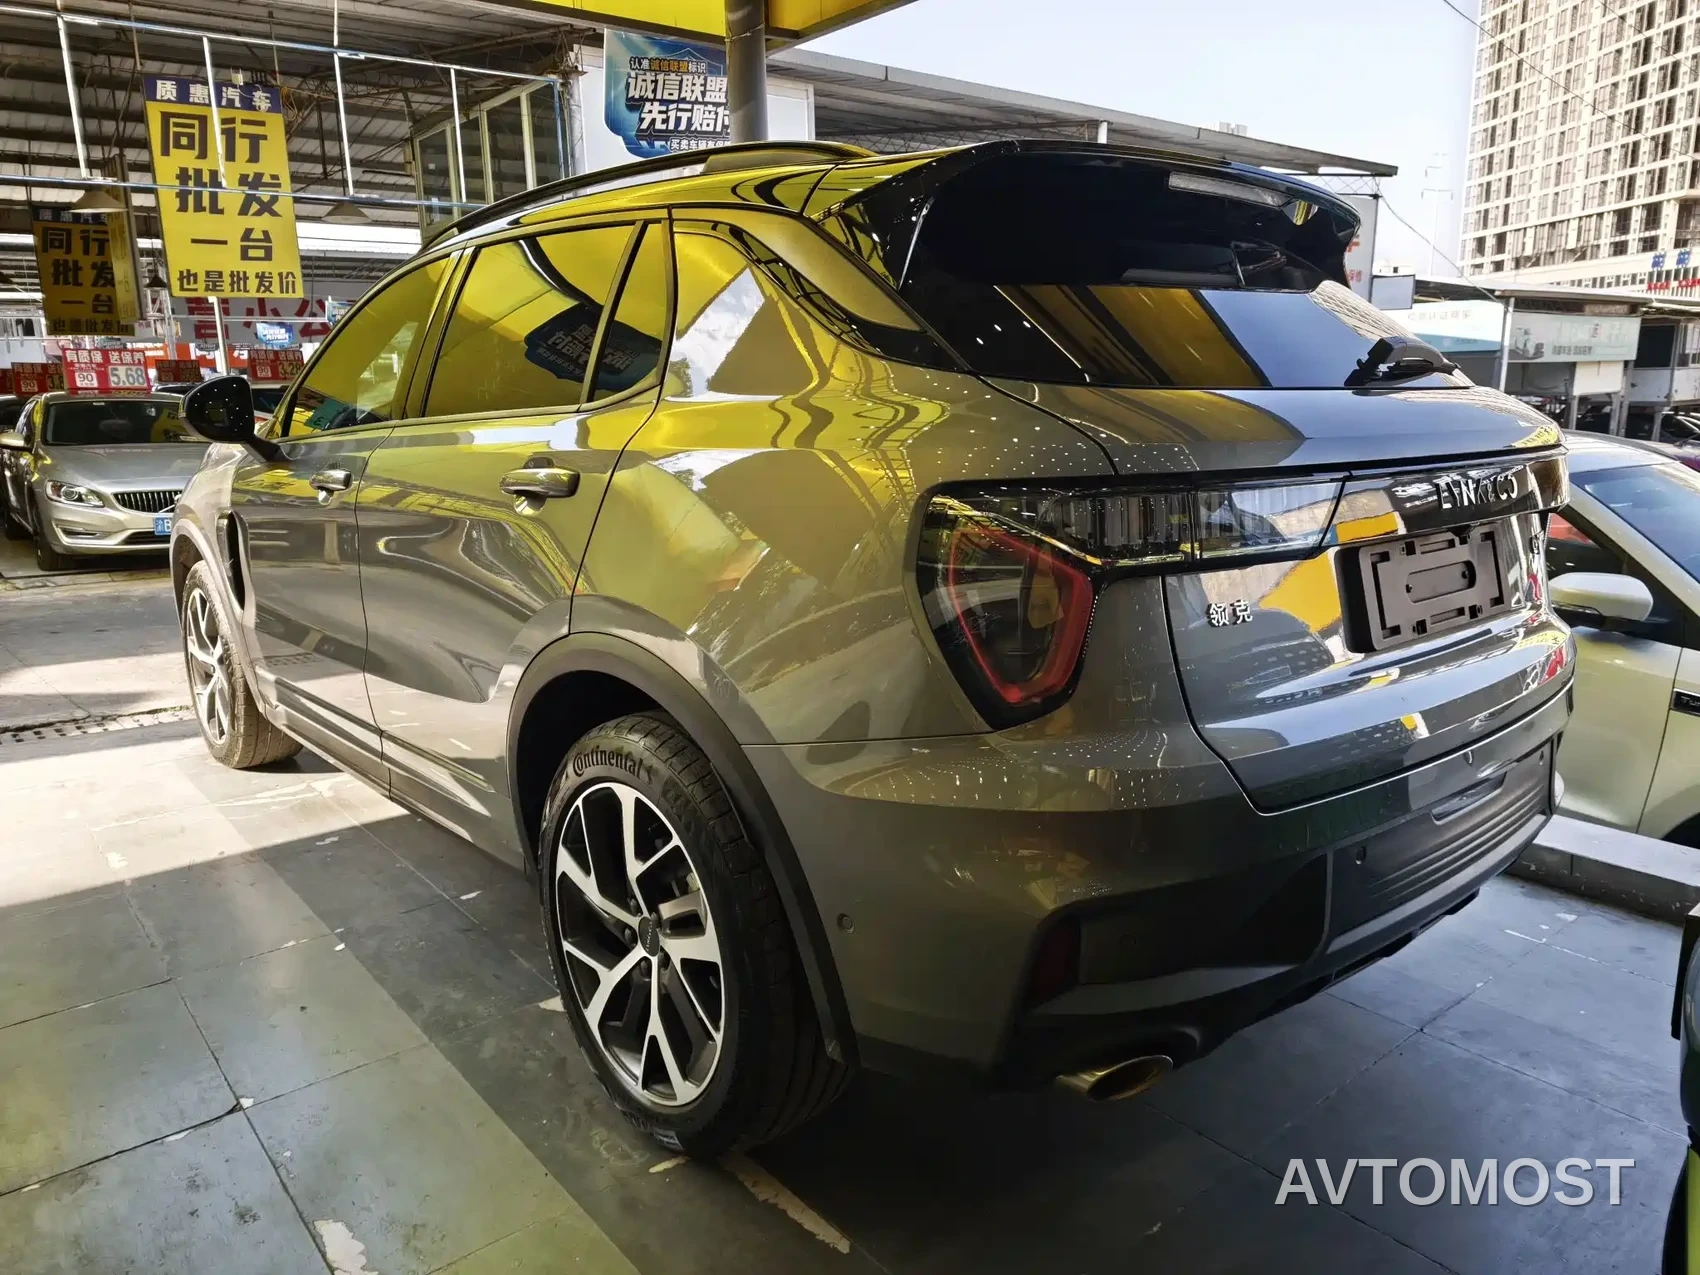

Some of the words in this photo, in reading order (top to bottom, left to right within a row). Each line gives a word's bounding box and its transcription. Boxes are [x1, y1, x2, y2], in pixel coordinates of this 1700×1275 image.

[630, 57, 707, 73] 认准诚信联盟标识
[627, 72, 728, 103] 诚信联盟
[160, 111, 268, 164] 同行
[175, 166, 283, 218] 批发
[190, 227, 273, 262] 一台
[177, 268, 297, 294] 也是批发价
[77, 373, 94, 382] 90
[109, 366, 146, 386] 5.68
[1207, 599, 1253, 627] 领克
[572, 744, 644, 778] Continental
